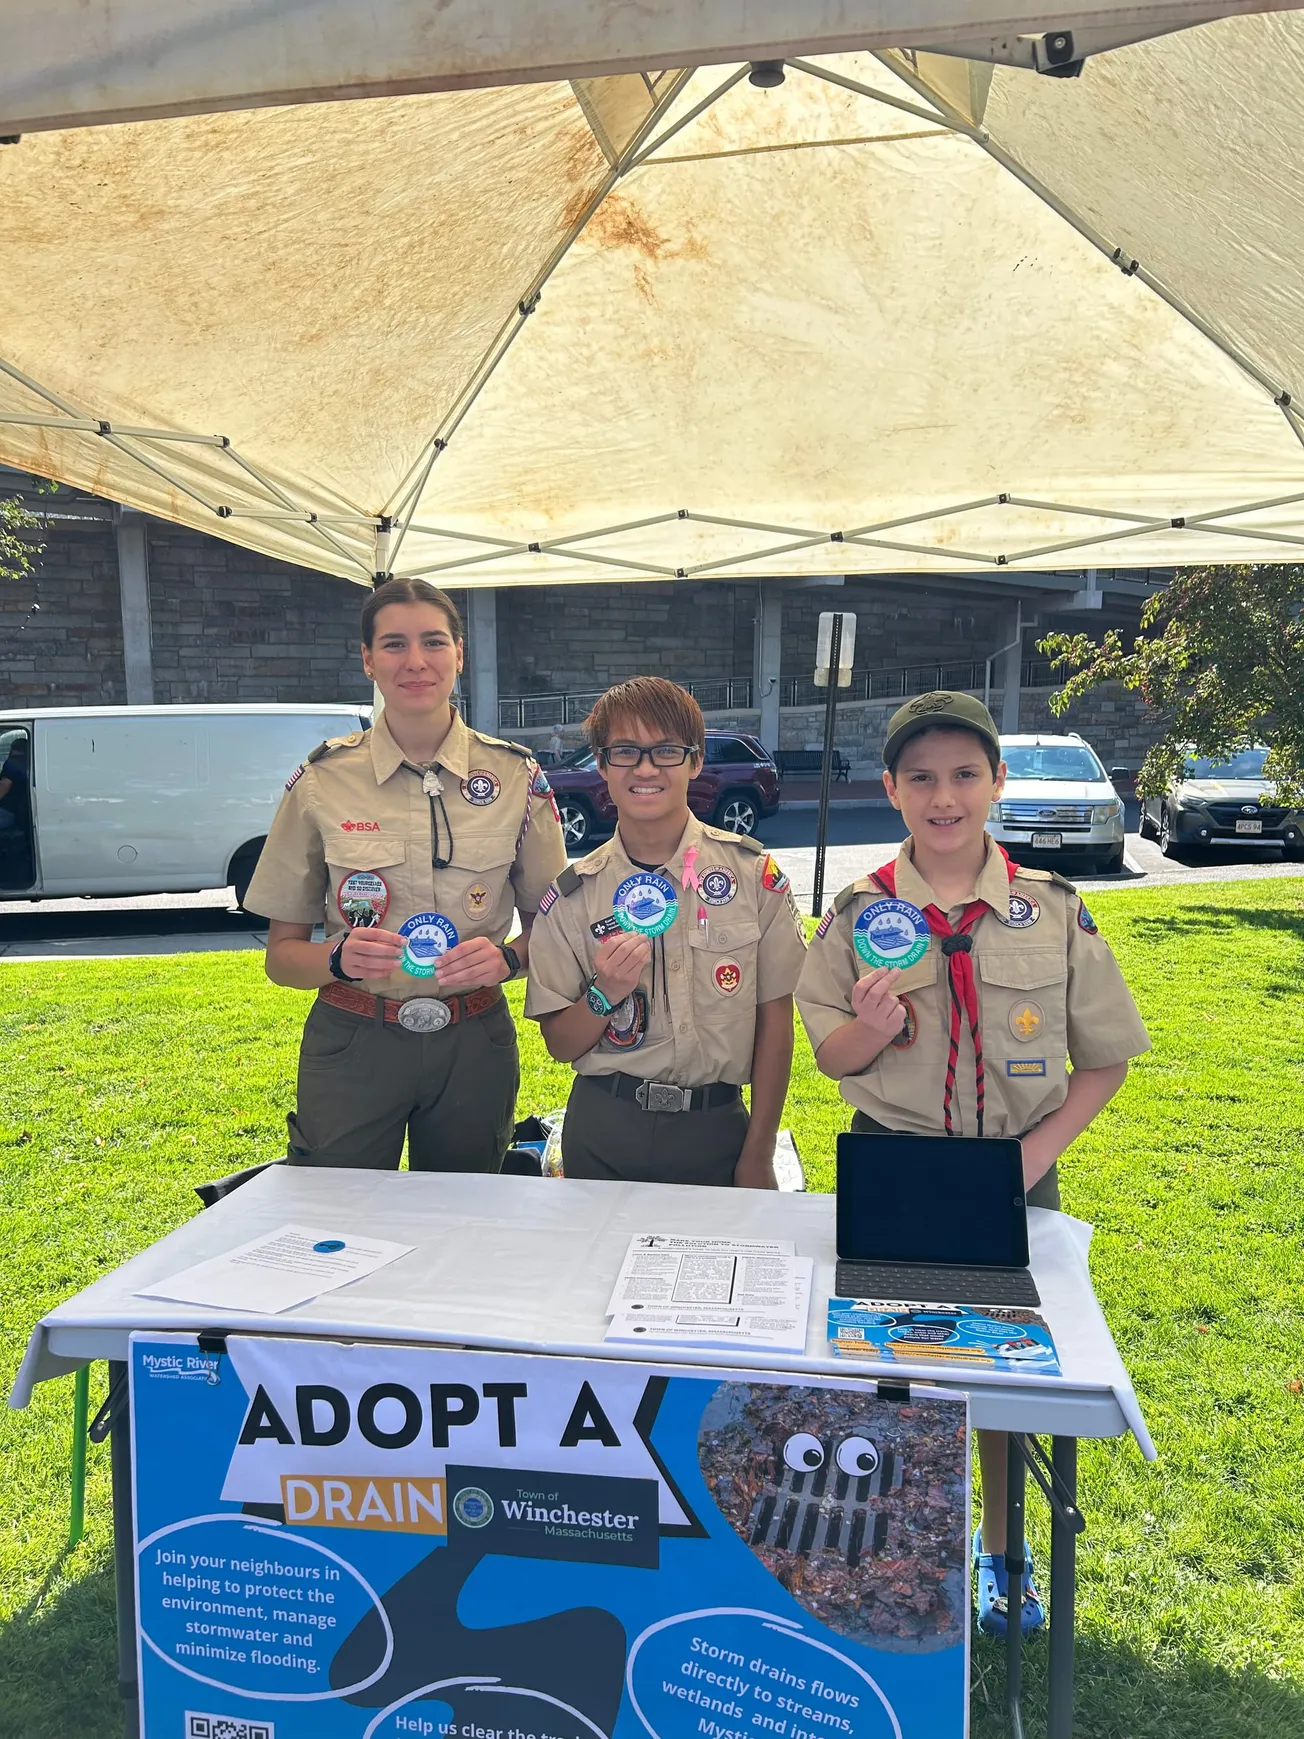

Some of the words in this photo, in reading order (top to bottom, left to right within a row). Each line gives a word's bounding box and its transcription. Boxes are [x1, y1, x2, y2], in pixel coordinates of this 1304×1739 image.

[356, 822, 381, 832] BSA
[618, 876, 642, 897] ONLY
[645, 875, 669, 893] RAIN
[617, 911, 633, 930] DOWN
[633, 924, 642, 934] THE
[645, 924, 665, 935] STORM
[663, 908, 676, 926] DRAIN
[863, 902, 893, 921] ONLY
[896, 902, 924, 925] RAIN
[408, 915, 435, 930] ONLY
[436, 917, 456, 940] RAIN
[404, 961, 415, 973] THE
[857, 939, 871, 958] DOWN
[871, 954, 885, 967] THE
[884, 957, 909, 969] STORM
[908, 942, 925, 962] DRAIN
[856, 1301, 929, 1309] ADOPT
[142, 1354, 183, 1369] Mystic
[187, 1356, 218, 1370] River
[238, 1382, 528, 1450] ADOPT
[558, 1380, 622, 1447] A
[285, 1479, 445, 1525] DRAIN
[516, 1488, 545, 1500] Town
[547, 1491, 560, 1501] of
[501, 1499, 640, 1530] Winchester
[544, 1525, 634, 1542] Massachusetts
[155, 1548, 186, 1565] Join
[190, 1555, 226, 1569] your
[230, 1558, 321, 1579] neighbours
[325, 1565, 340, 1581] in
[163, 1572, 220, 1594] helping
[224, 1580, 241, 1594] to
[245, 1583, 304, 1601] protect
[307, 1588, 335, 1604] the
[162, 1595, 269, 1621] environment,
[272, 1608, 337, 1630] manage
[185, 1621, 279, 1644] stormwater
[283, 1633, 313, 1647] and
[176, 1641, 246, 1664] minimize
[250, 1650, 321, 1674] flooding.
[690, 1637, 745, 1668] Storm
[749, 1658, 807, 1690] drains
[810, 1680, 860, 1708] flows
[662, 1680, 743, 1719] wetlands
[751, 1713, 787, 1735] and
[681, 1660, 750, 1697] directly
[753, 1685, 772, 1703] to
[776, 1696, 855, 1735] streams,
[395, 1715, 433, 1737] Help
[438, 1722, 458, 1735] us
[461, 1722, 503, 1739] clear
[697, 1717, 755, 1739] Mysti
